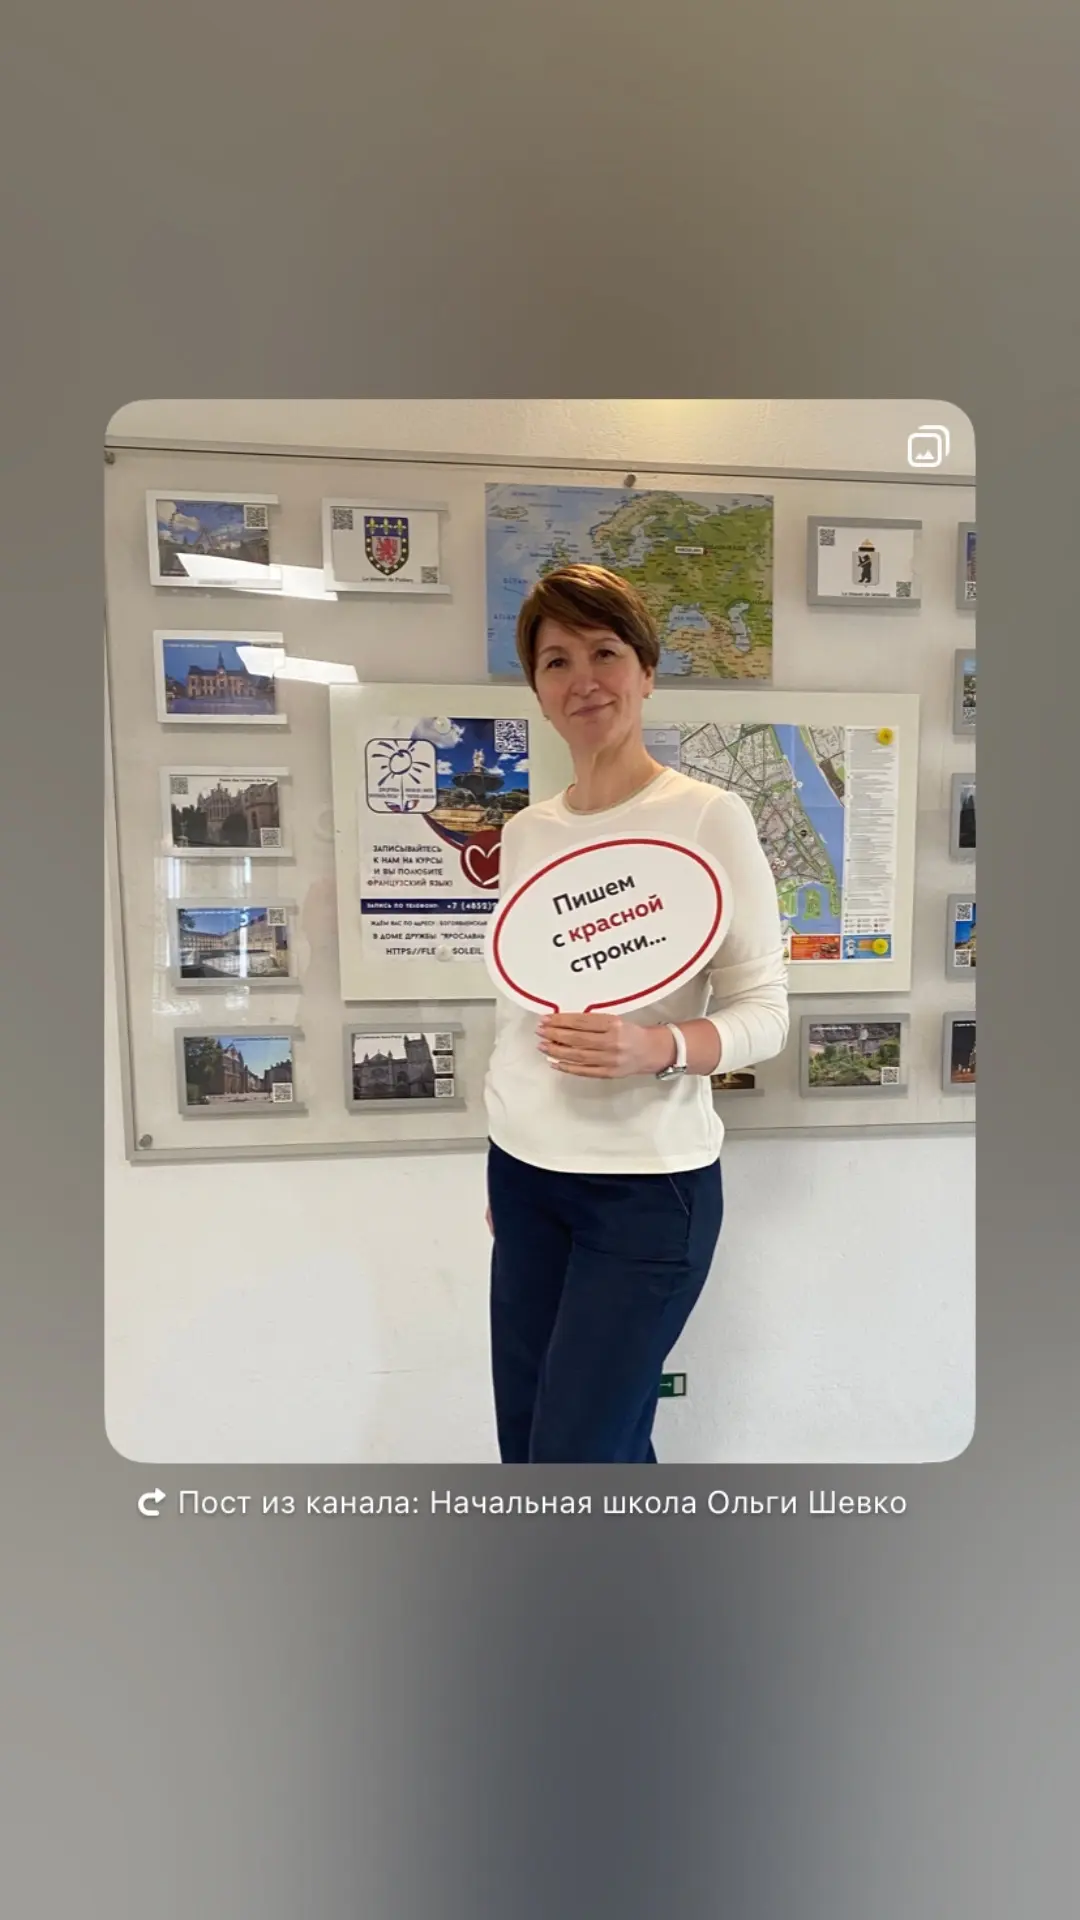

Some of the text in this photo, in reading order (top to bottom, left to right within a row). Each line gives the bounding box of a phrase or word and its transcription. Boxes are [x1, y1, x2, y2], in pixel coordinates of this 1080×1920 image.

[373, 844, 442, 852] ЗАПИСЫВАЙТЕСЬ
[367, 878, 427, 886] ФРАНЦУЗСКИЙ
[552, 875, 635, 915] Пишем
[552, 893, 664, 948] с красной
[570, 935, 667, 973] строки...
